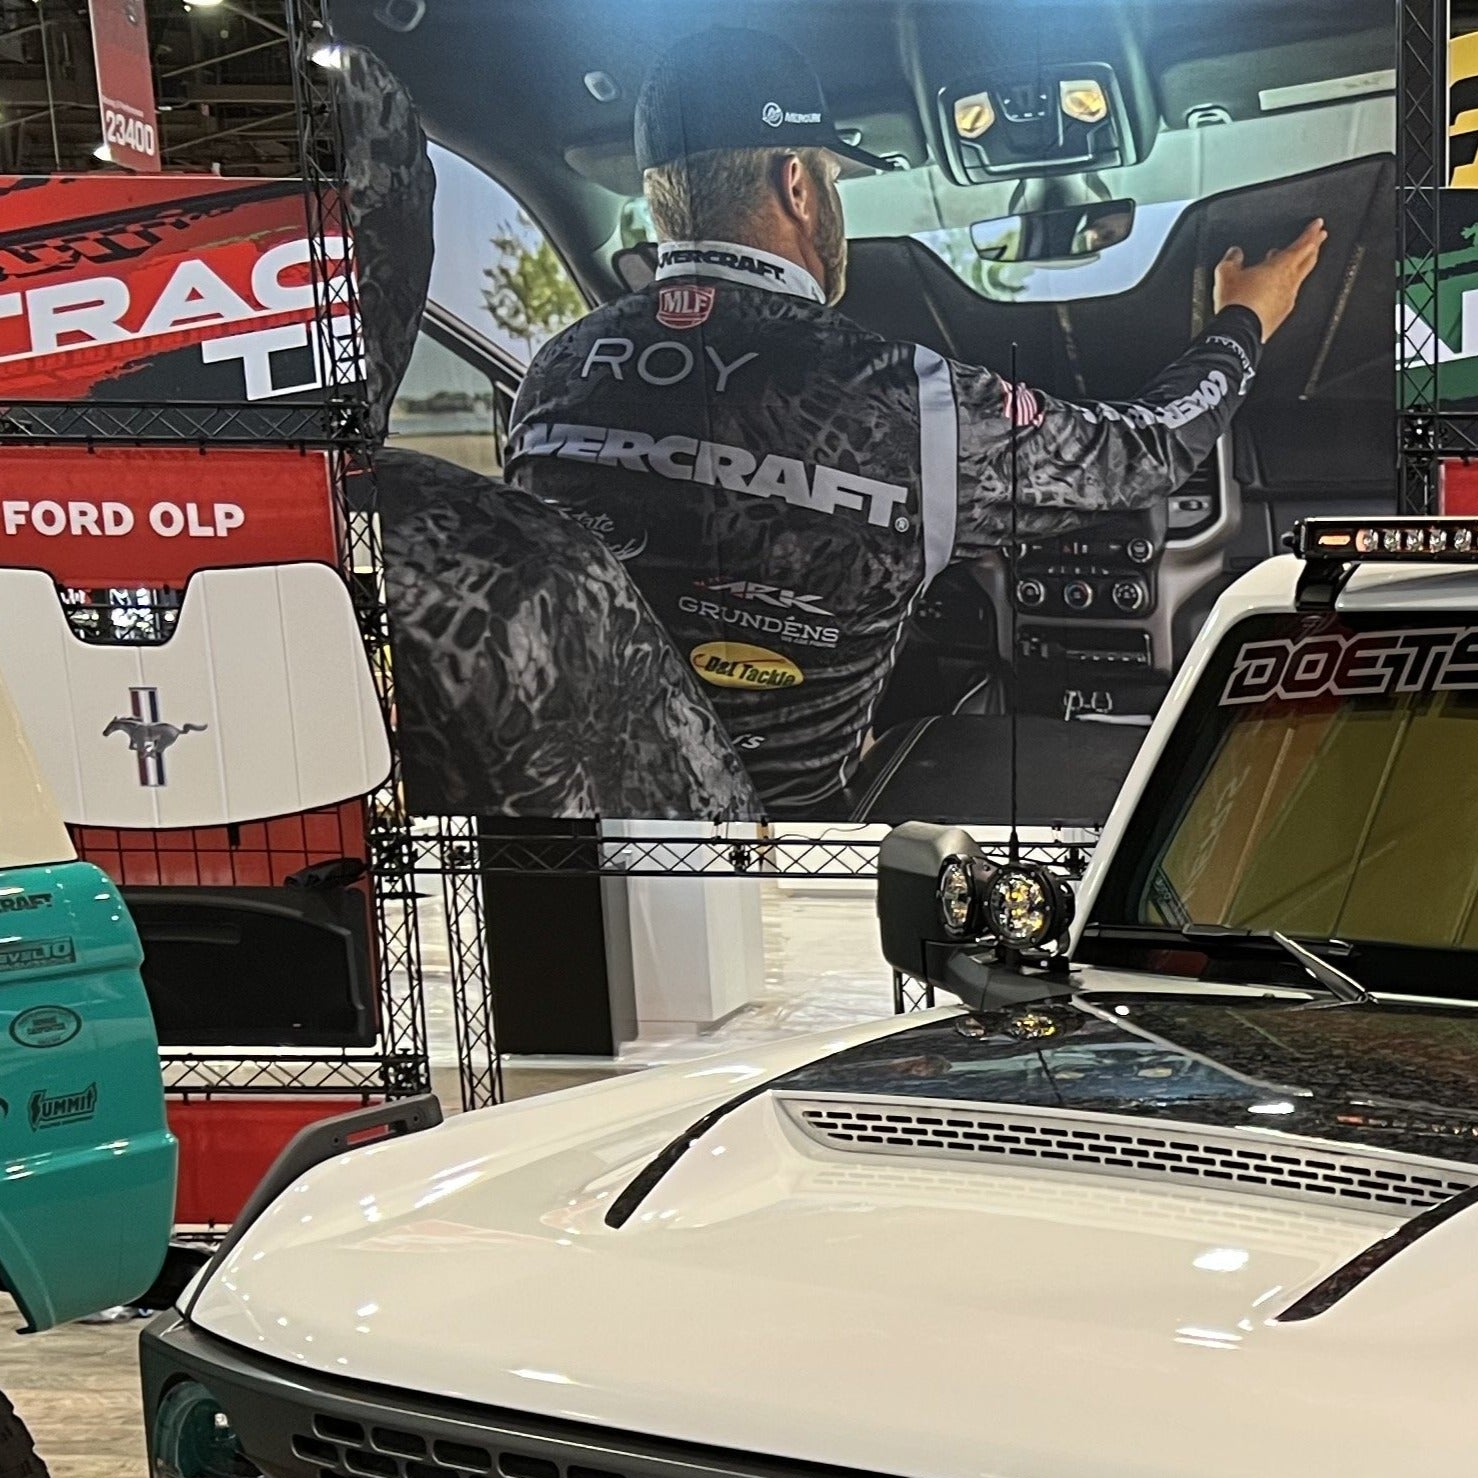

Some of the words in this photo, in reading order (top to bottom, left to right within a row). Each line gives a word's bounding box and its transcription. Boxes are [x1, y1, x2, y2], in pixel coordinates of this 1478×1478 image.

[105, 110, 155, 156] 23400
[659, 250, 785, 280] VERCRAFT
[663, 289, 710, 314] MLF
[581, 338, 759, 393] ROY
[520, 422, 909, 528] VERCRAFT
[2, 499, 136, 537] FORD
[148, 499, 246, 538] OLP
[739, 664, 797, 687] Tackle
